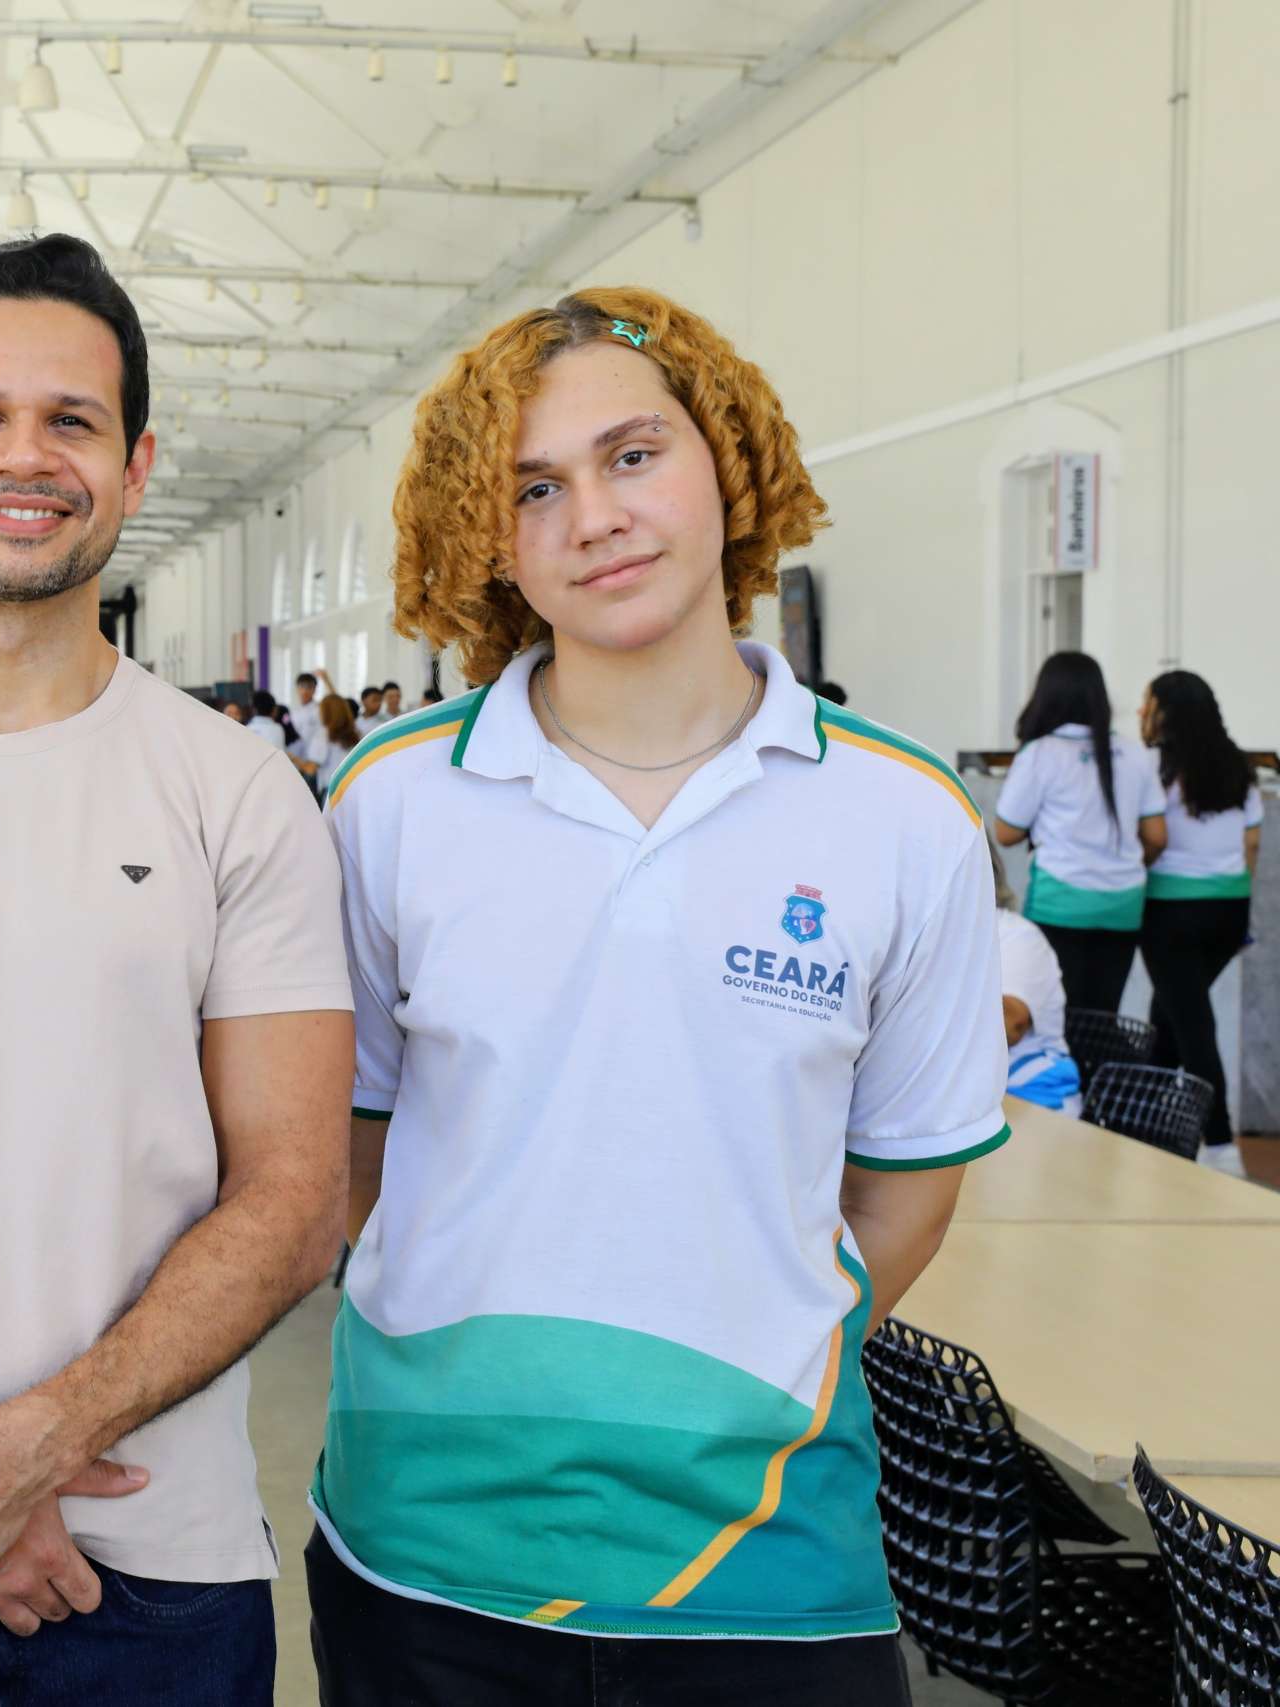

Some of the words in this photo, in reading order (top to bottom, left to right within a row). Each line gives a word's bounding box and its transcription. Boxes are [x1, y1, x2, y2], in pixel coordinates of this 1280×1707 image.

[725, 945, 849, 998] CEARÁ
[723, 975, 788, 997] GOVERNO
[791, 990, 808, 1002] DO
[741, 995, 786, 1011] SECRETARIA
[788, 1006, 798, 1014] DA
